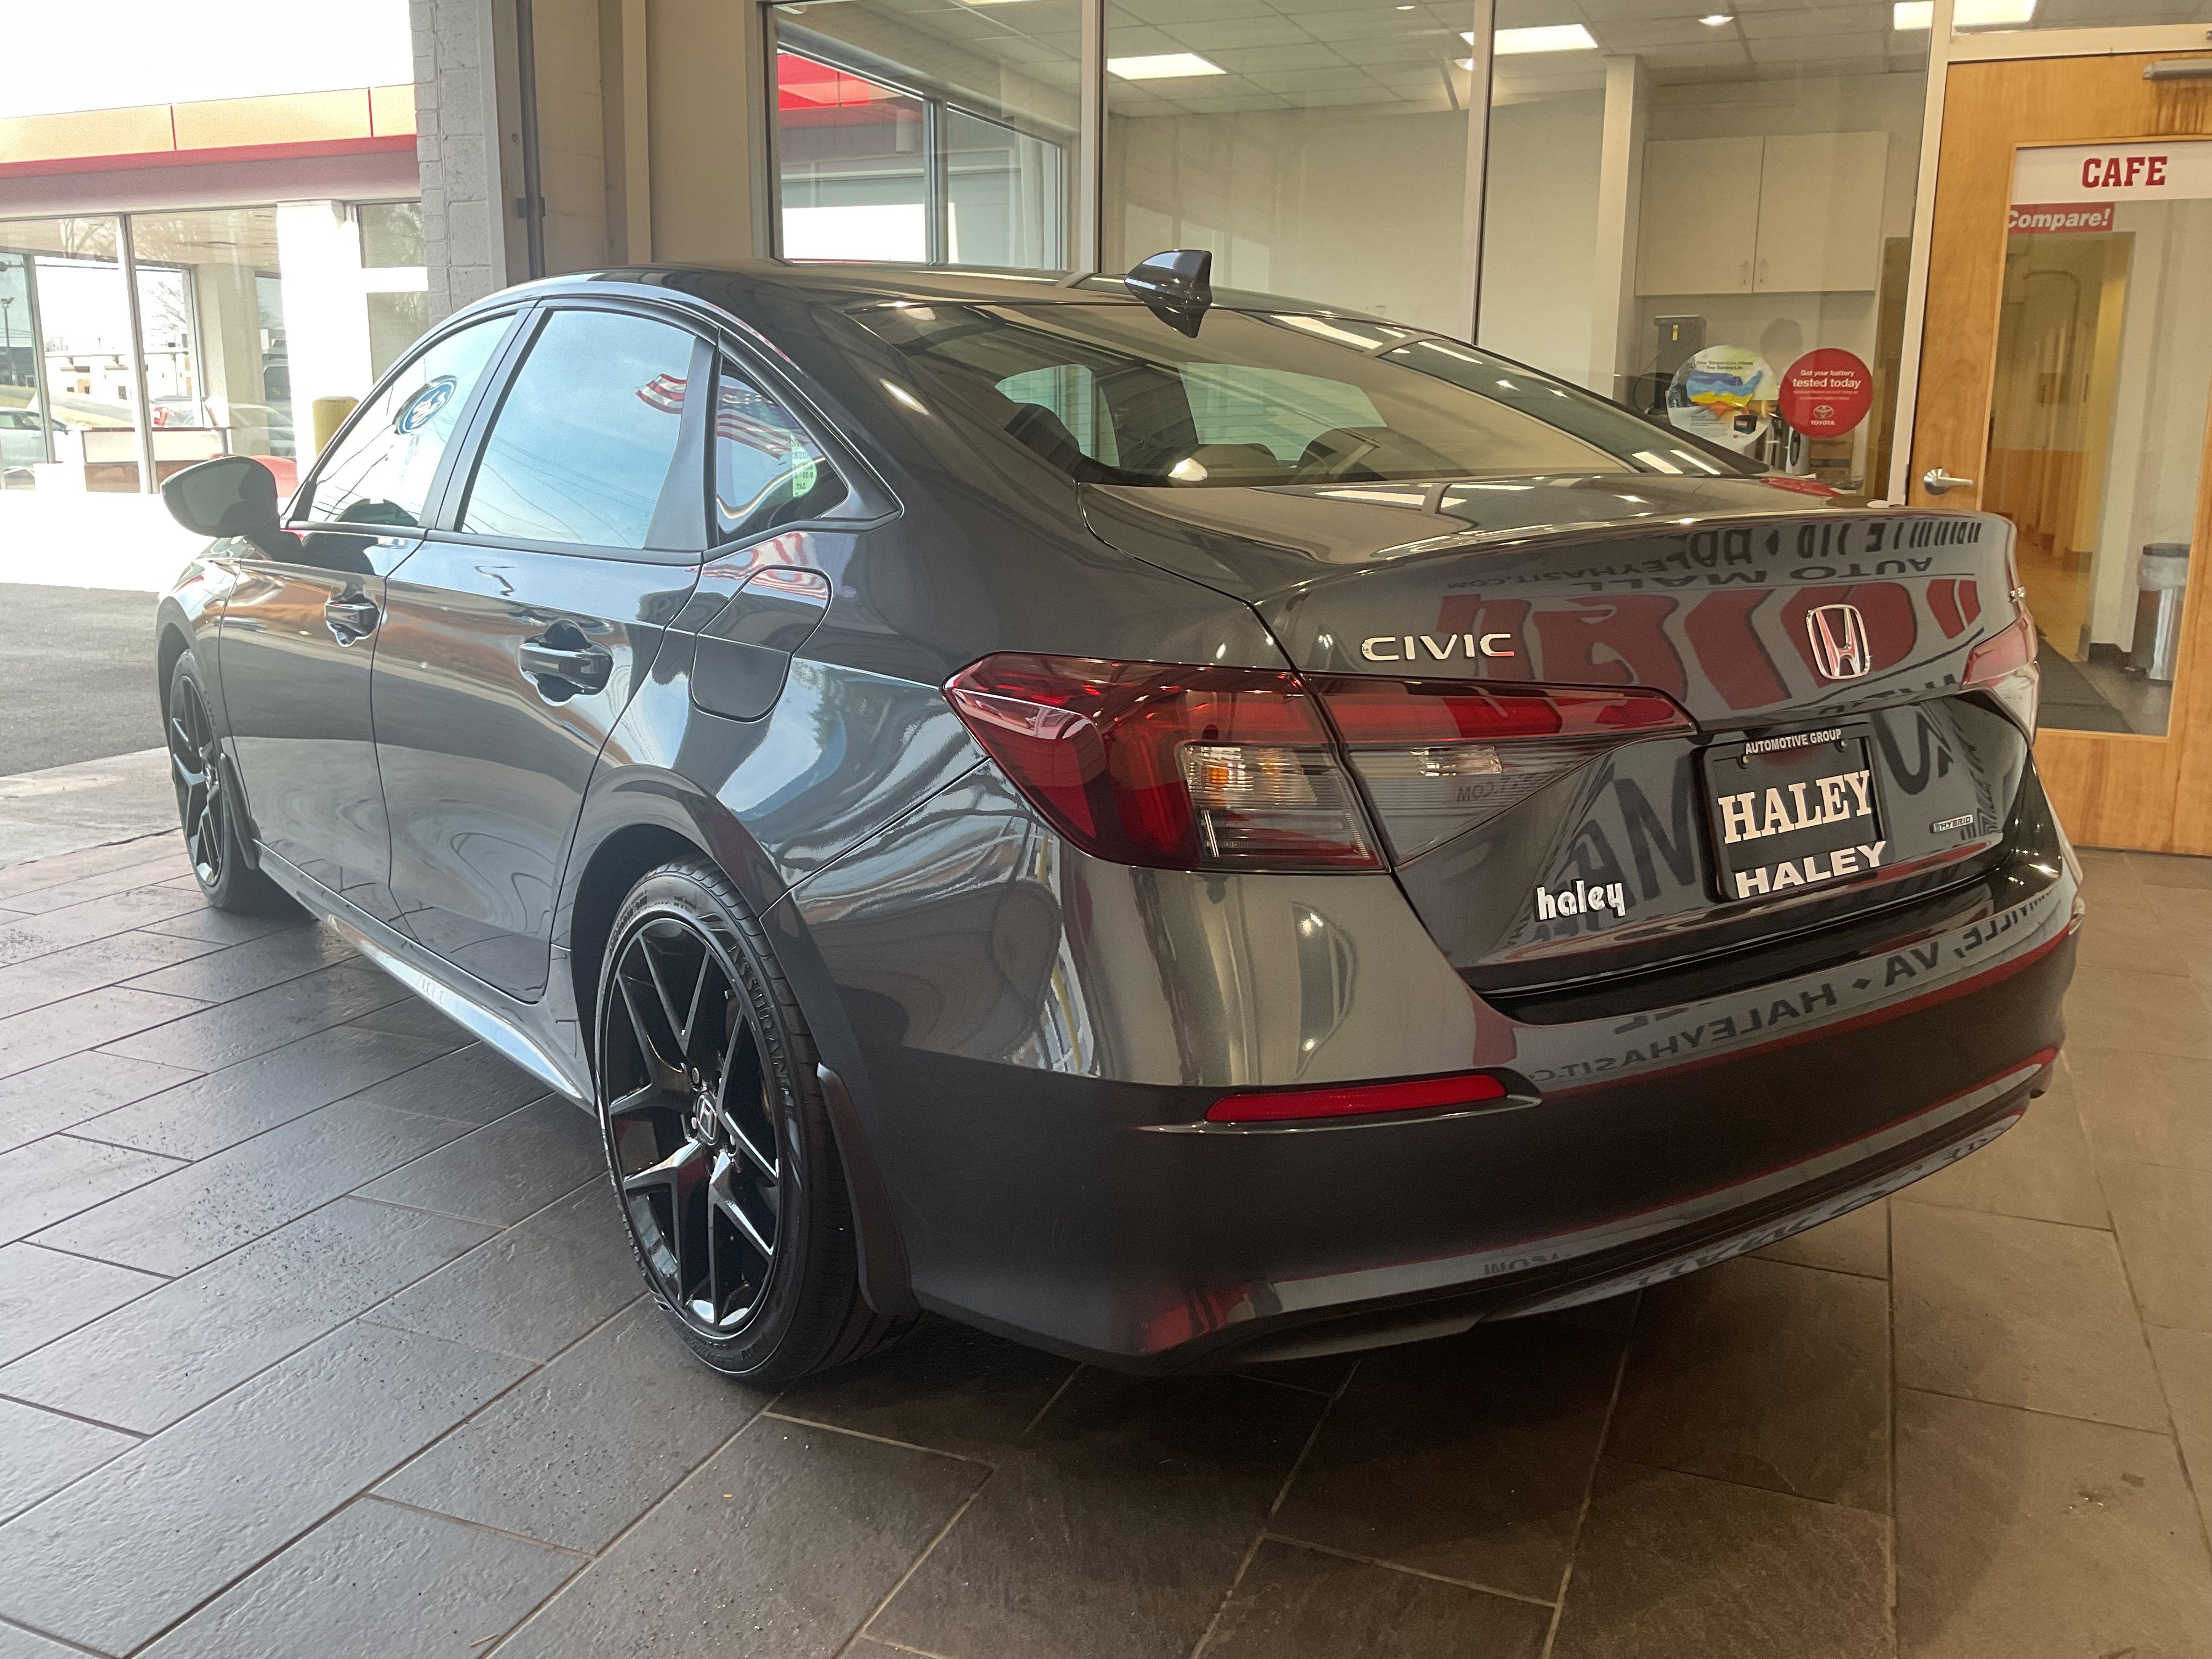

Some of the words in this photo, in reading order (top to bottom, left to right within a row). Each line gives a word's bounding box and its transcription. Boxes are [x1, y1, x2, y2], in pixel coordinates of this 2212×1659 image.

[2081, 156, 2168, 188] CAFE
[2008, 209, 2111, 231] Compare!
[1793, 378, 1827, 388] tested
[1830, 379, 1861, 390] today
[1830, 369, 1855, 377] battery
[1361, 633, 1516, 662] CIVIC
[1745, 734, 1808, 754] AUTOMOTIVE
[1809, 729, 1842, 744] GROUP
[1718, 770, 1872, 845] HALEY
[1940, 816, 1971, 830] HYBRID
[1735, 841, 1886, 899] HALEY
[1536, 879, 1626, 922] haley
